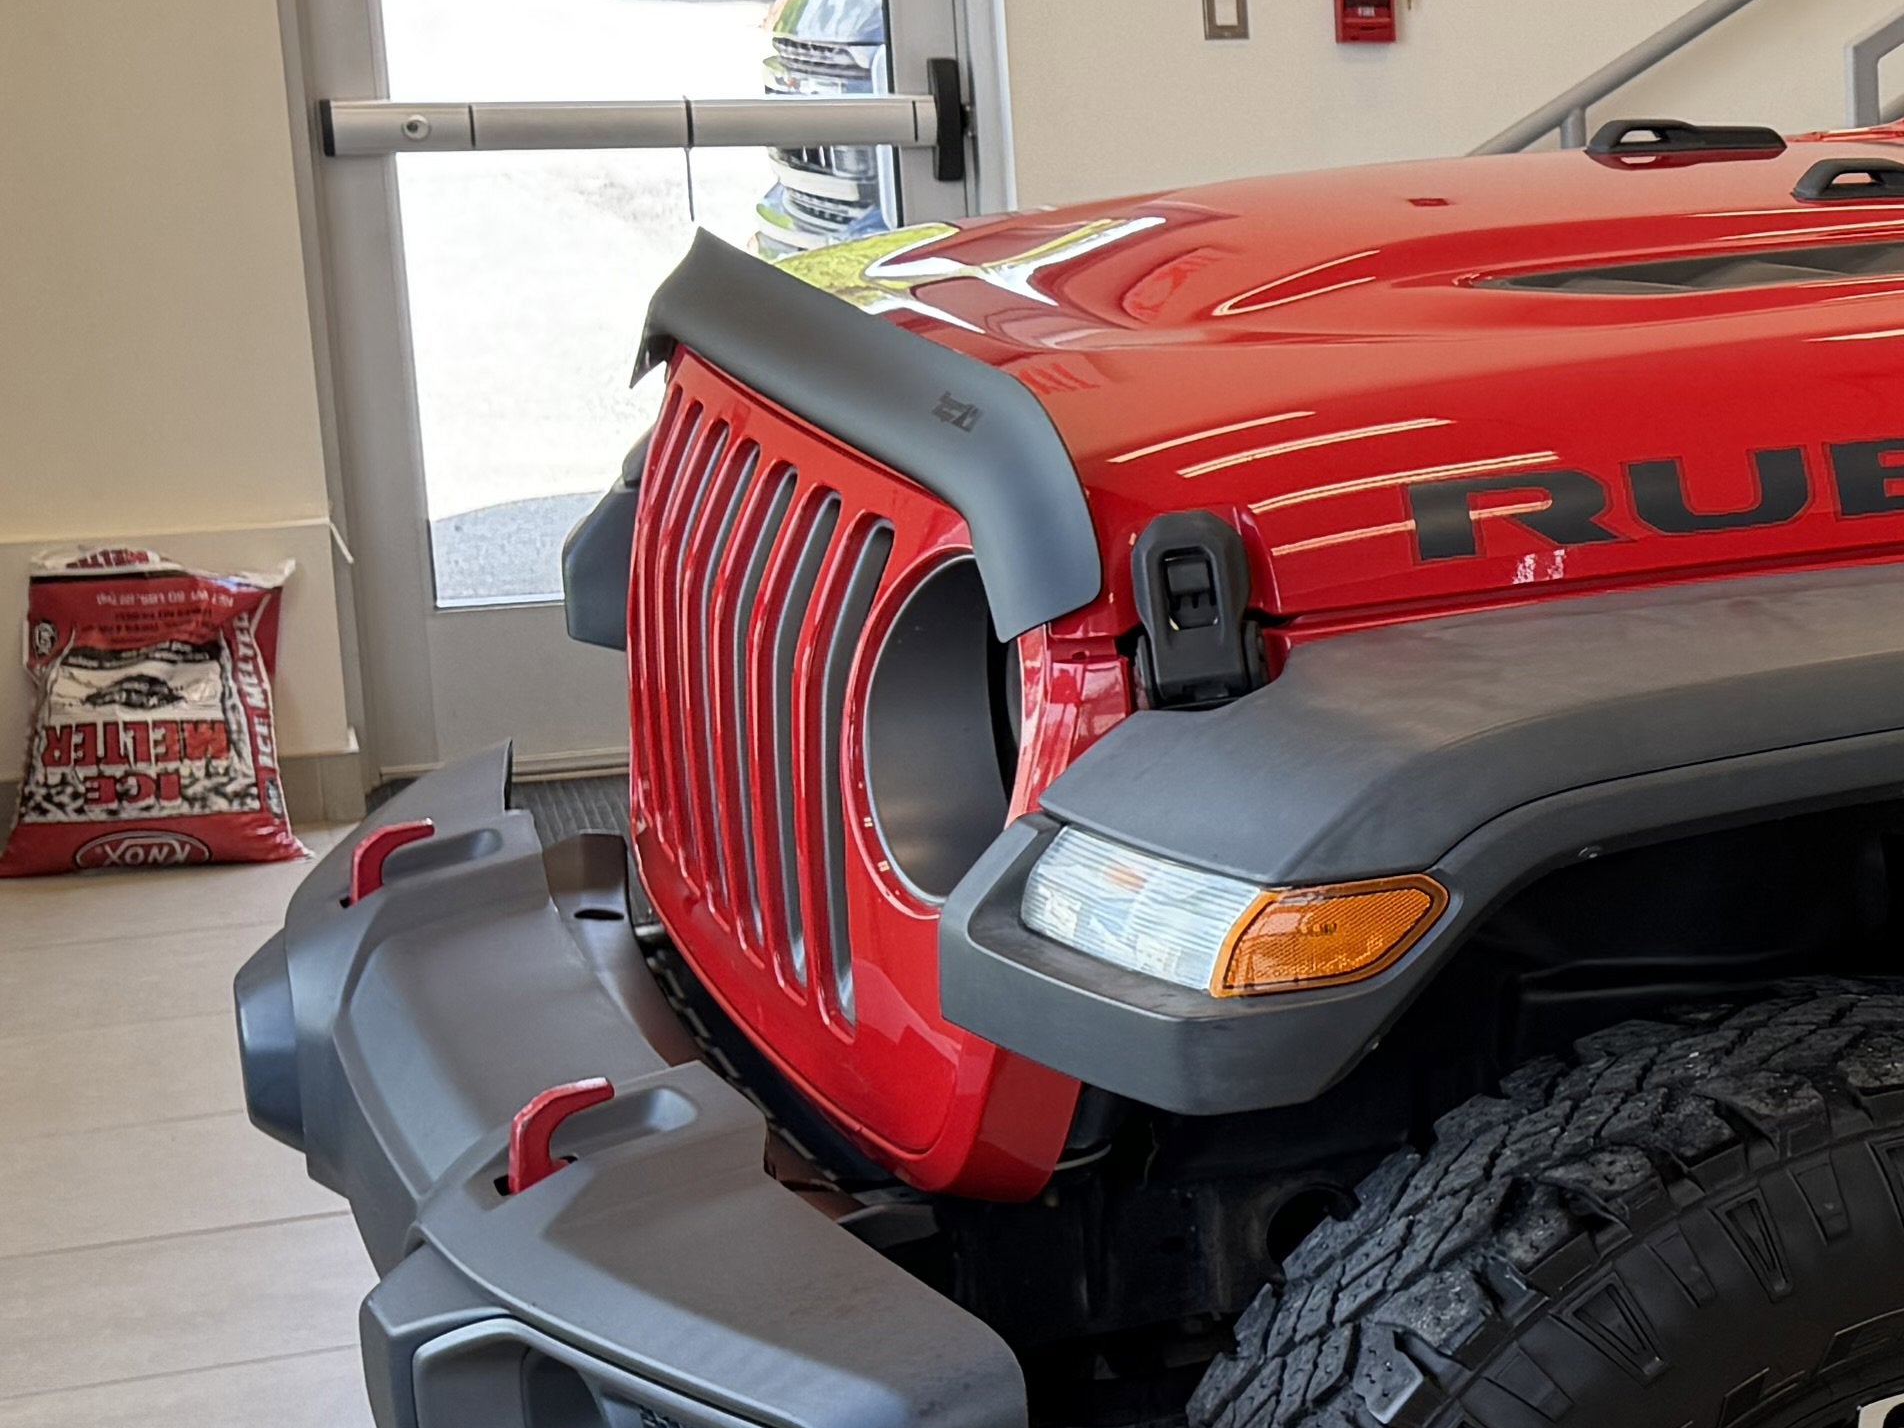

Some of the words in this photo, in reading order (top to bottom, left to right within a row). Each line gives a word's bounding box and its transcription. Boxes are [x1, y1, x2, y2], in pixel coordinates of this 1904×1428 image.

[41, 719, 231, 768] MELTER
[253, 715, 275, 768] ICE
[83, 772, 182, 807] ICE
[104, 837, 191, 866] KNOX
